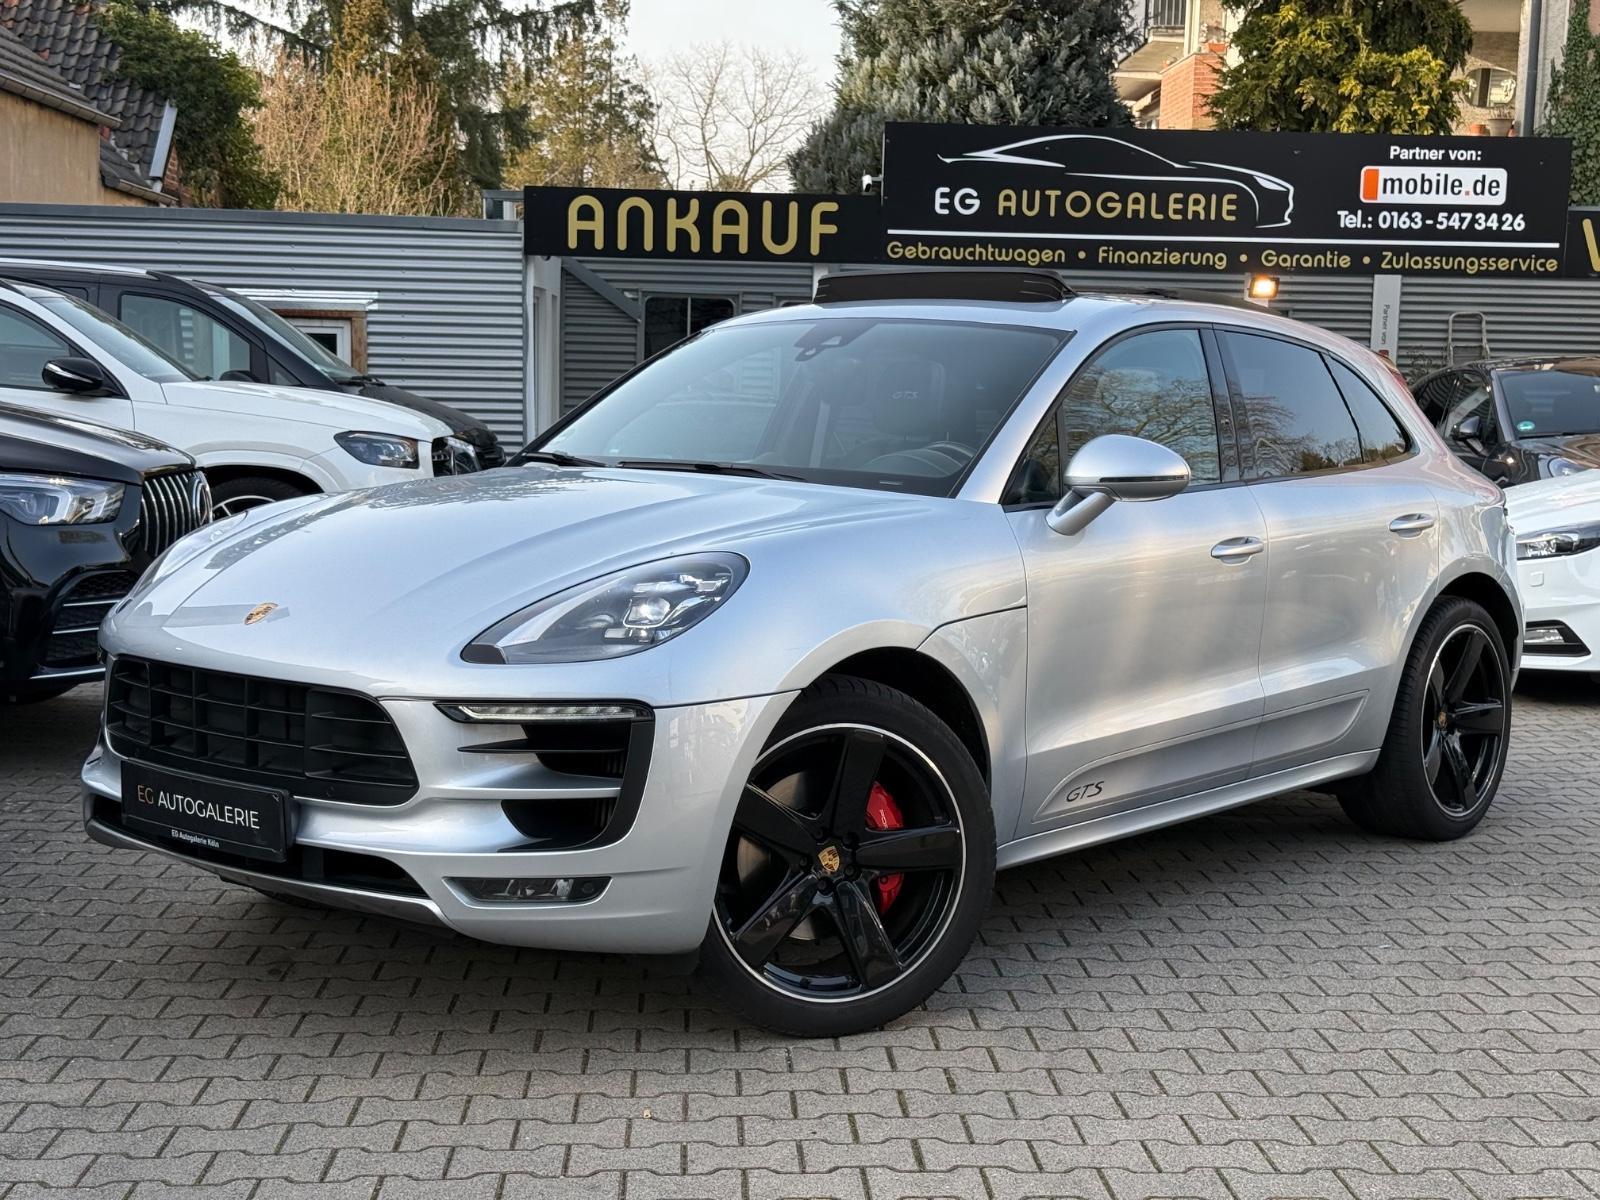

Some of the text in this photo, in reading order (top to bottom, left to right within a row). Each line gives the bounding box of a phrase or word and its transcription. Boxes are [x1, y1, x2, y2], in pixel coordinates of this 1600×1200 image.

[1389, 145, 1482, 162] Partner von:
[1381, 173, 1501, 197] mobile.de
[934, 186, 1238, 222] EG AUTOGALERIE
[567, 194, 839, 257] ANKAUF
[1336, 209, 1374, 230] Tel.:
[886, 241, 1559, 276] Gebrauchtwagen Finanzierung Garantie Zulassungsservice
[1066, 780, 1104, 802] GTS
[137, 784, 261, 830] EG AUTOGALERIE
